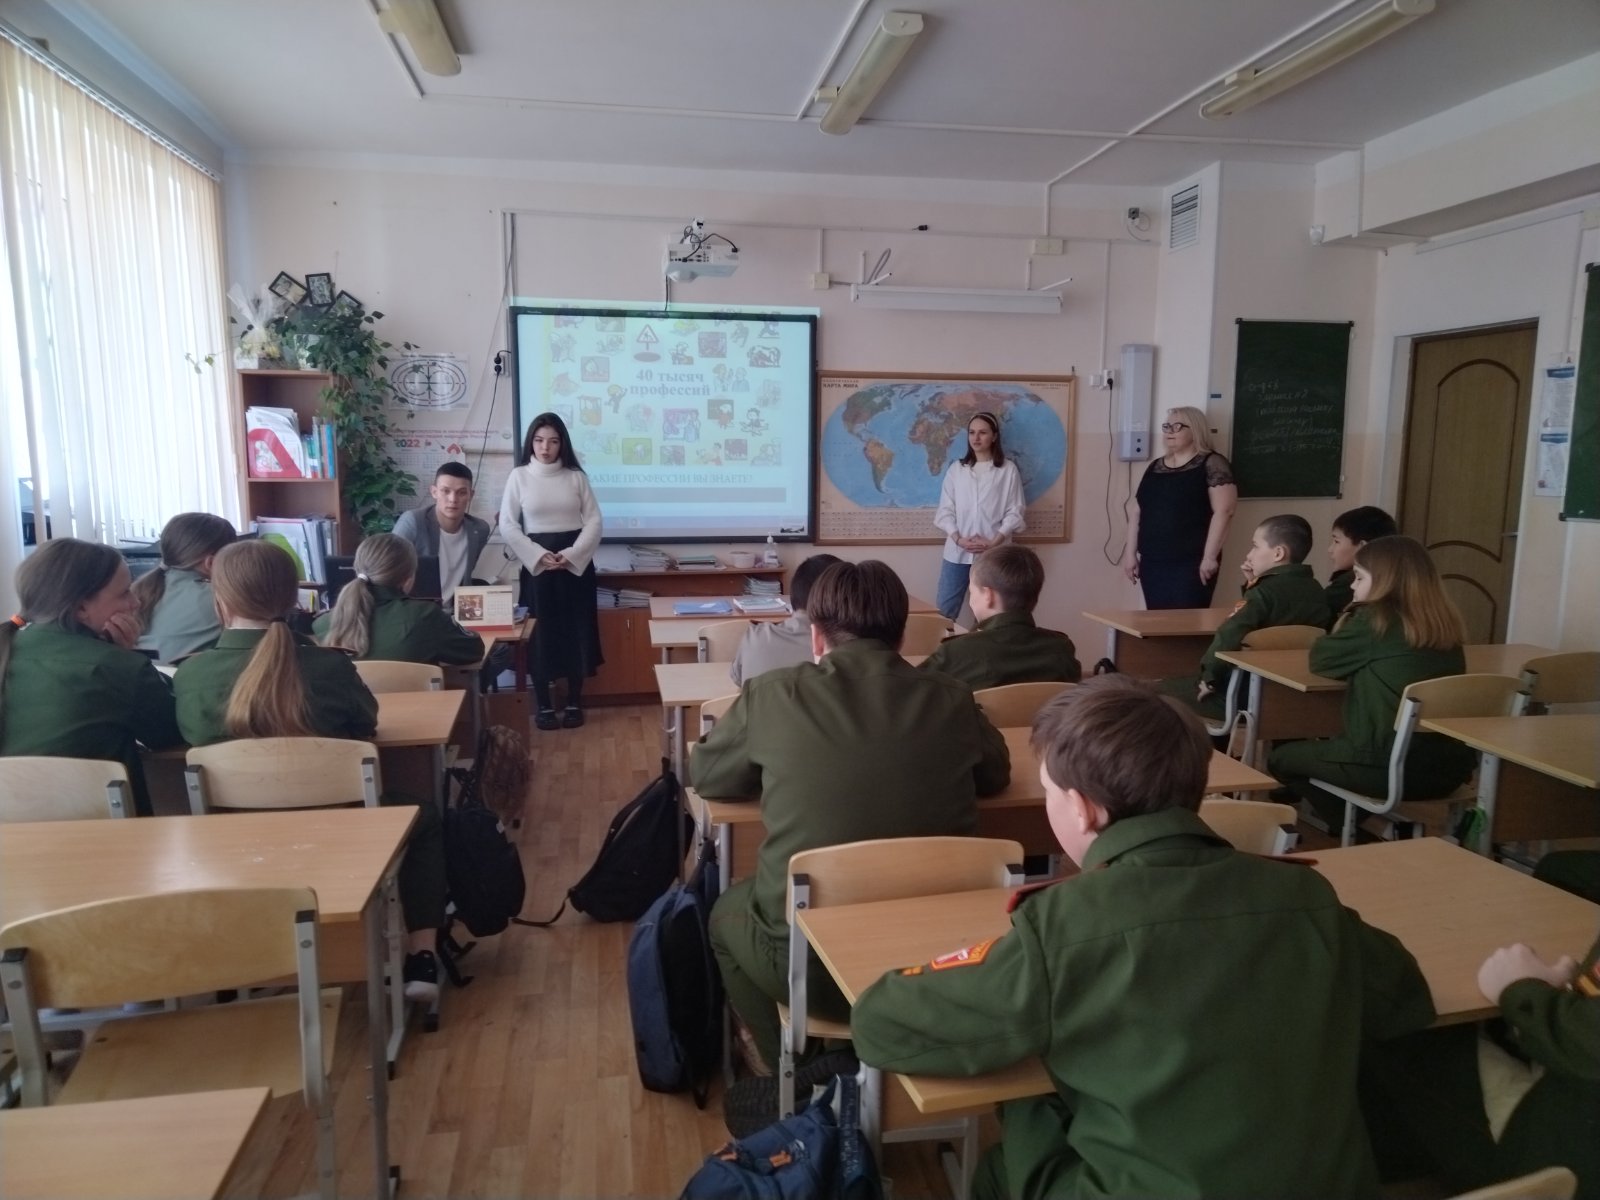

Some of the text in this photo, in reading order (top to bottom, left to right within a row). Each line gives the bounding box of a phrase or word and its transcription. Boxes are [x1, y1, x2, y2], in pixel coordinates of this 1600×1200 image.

[636, 370, 704, 383] 40 тысяч
[630, 383, 711, 397] профессий
[393, 438, 421, 448] 2022
[623, 473, 690, 484] ПРОФЕССИИ
